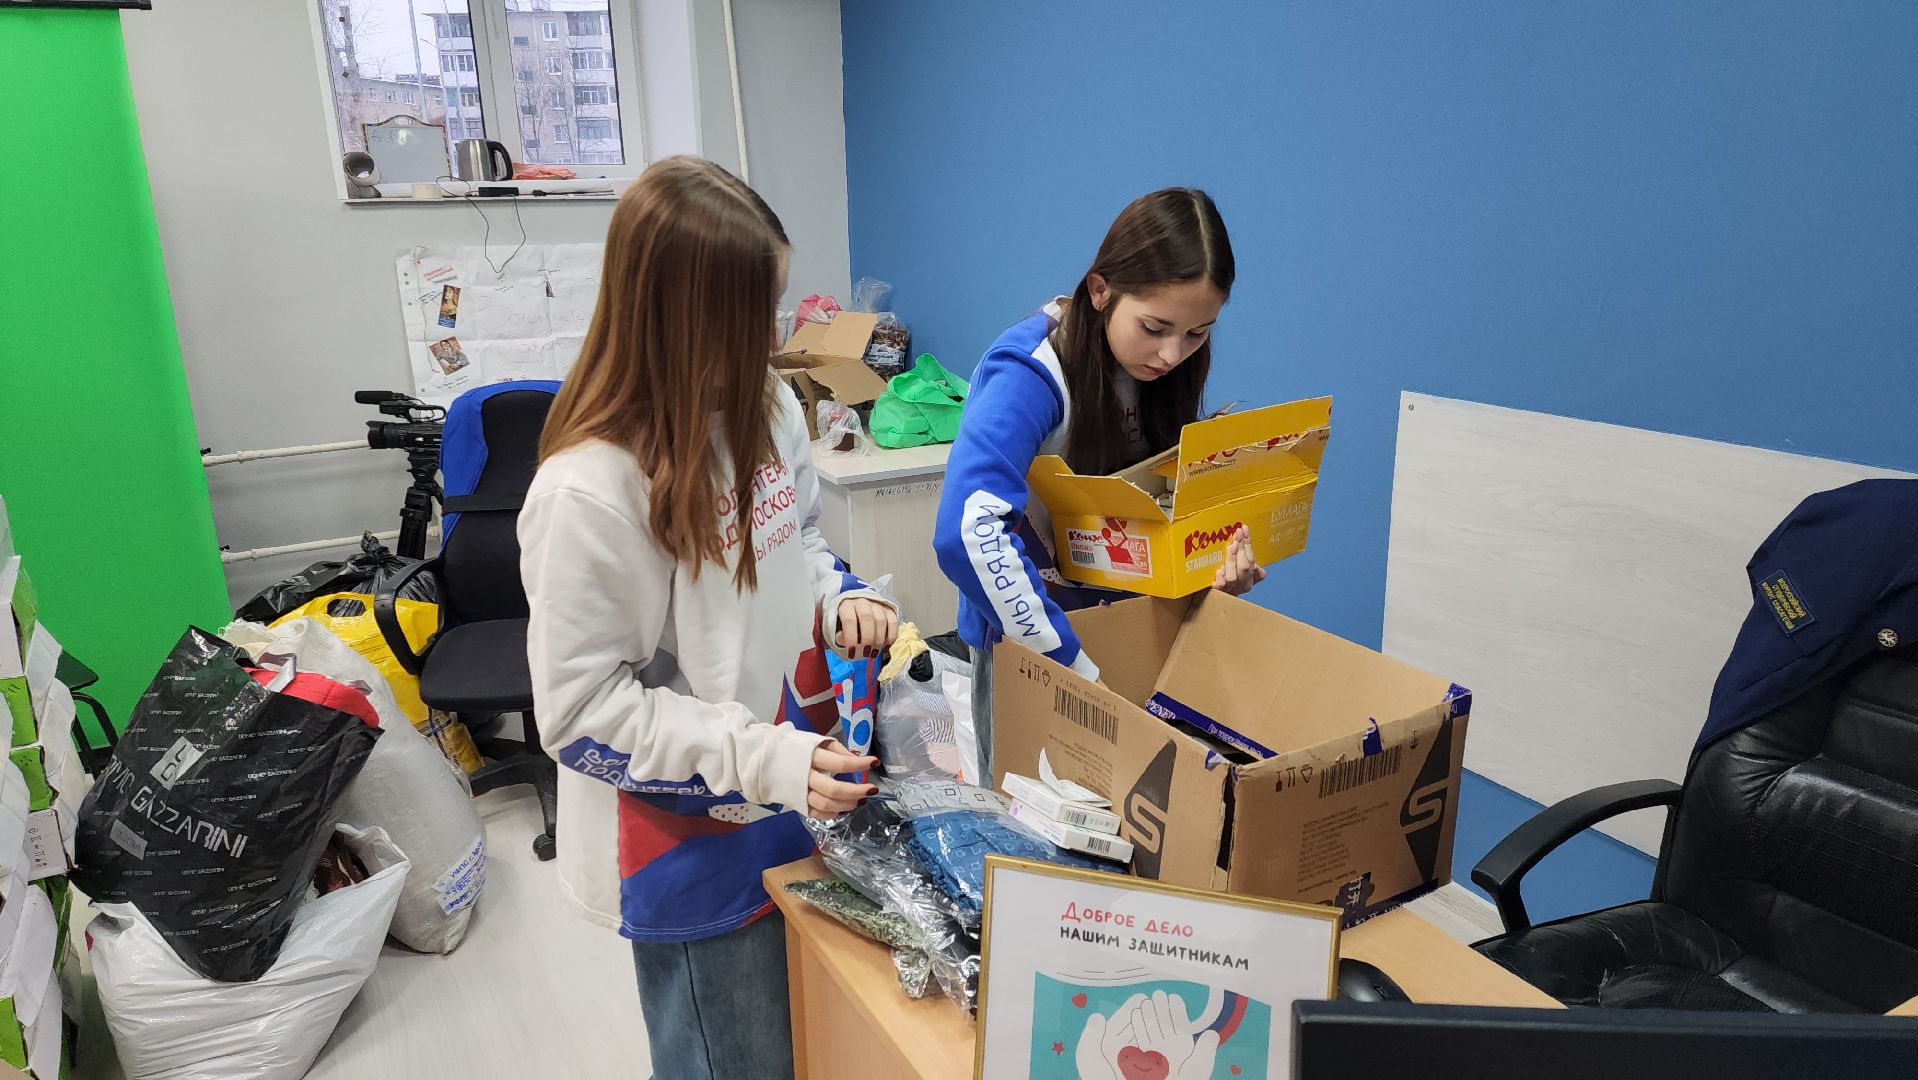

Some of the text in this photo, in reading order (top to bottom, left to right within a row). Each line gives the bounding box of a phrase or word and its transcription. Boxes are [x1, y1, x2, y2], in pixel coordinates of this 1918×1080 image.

[1185, 550, 1223, 573] STANDARD
[130, 785, 249, 859] GAZZARINI
[1059, 926, 1250, 971] НАШИМ ЗАЩИТНИКАМ
